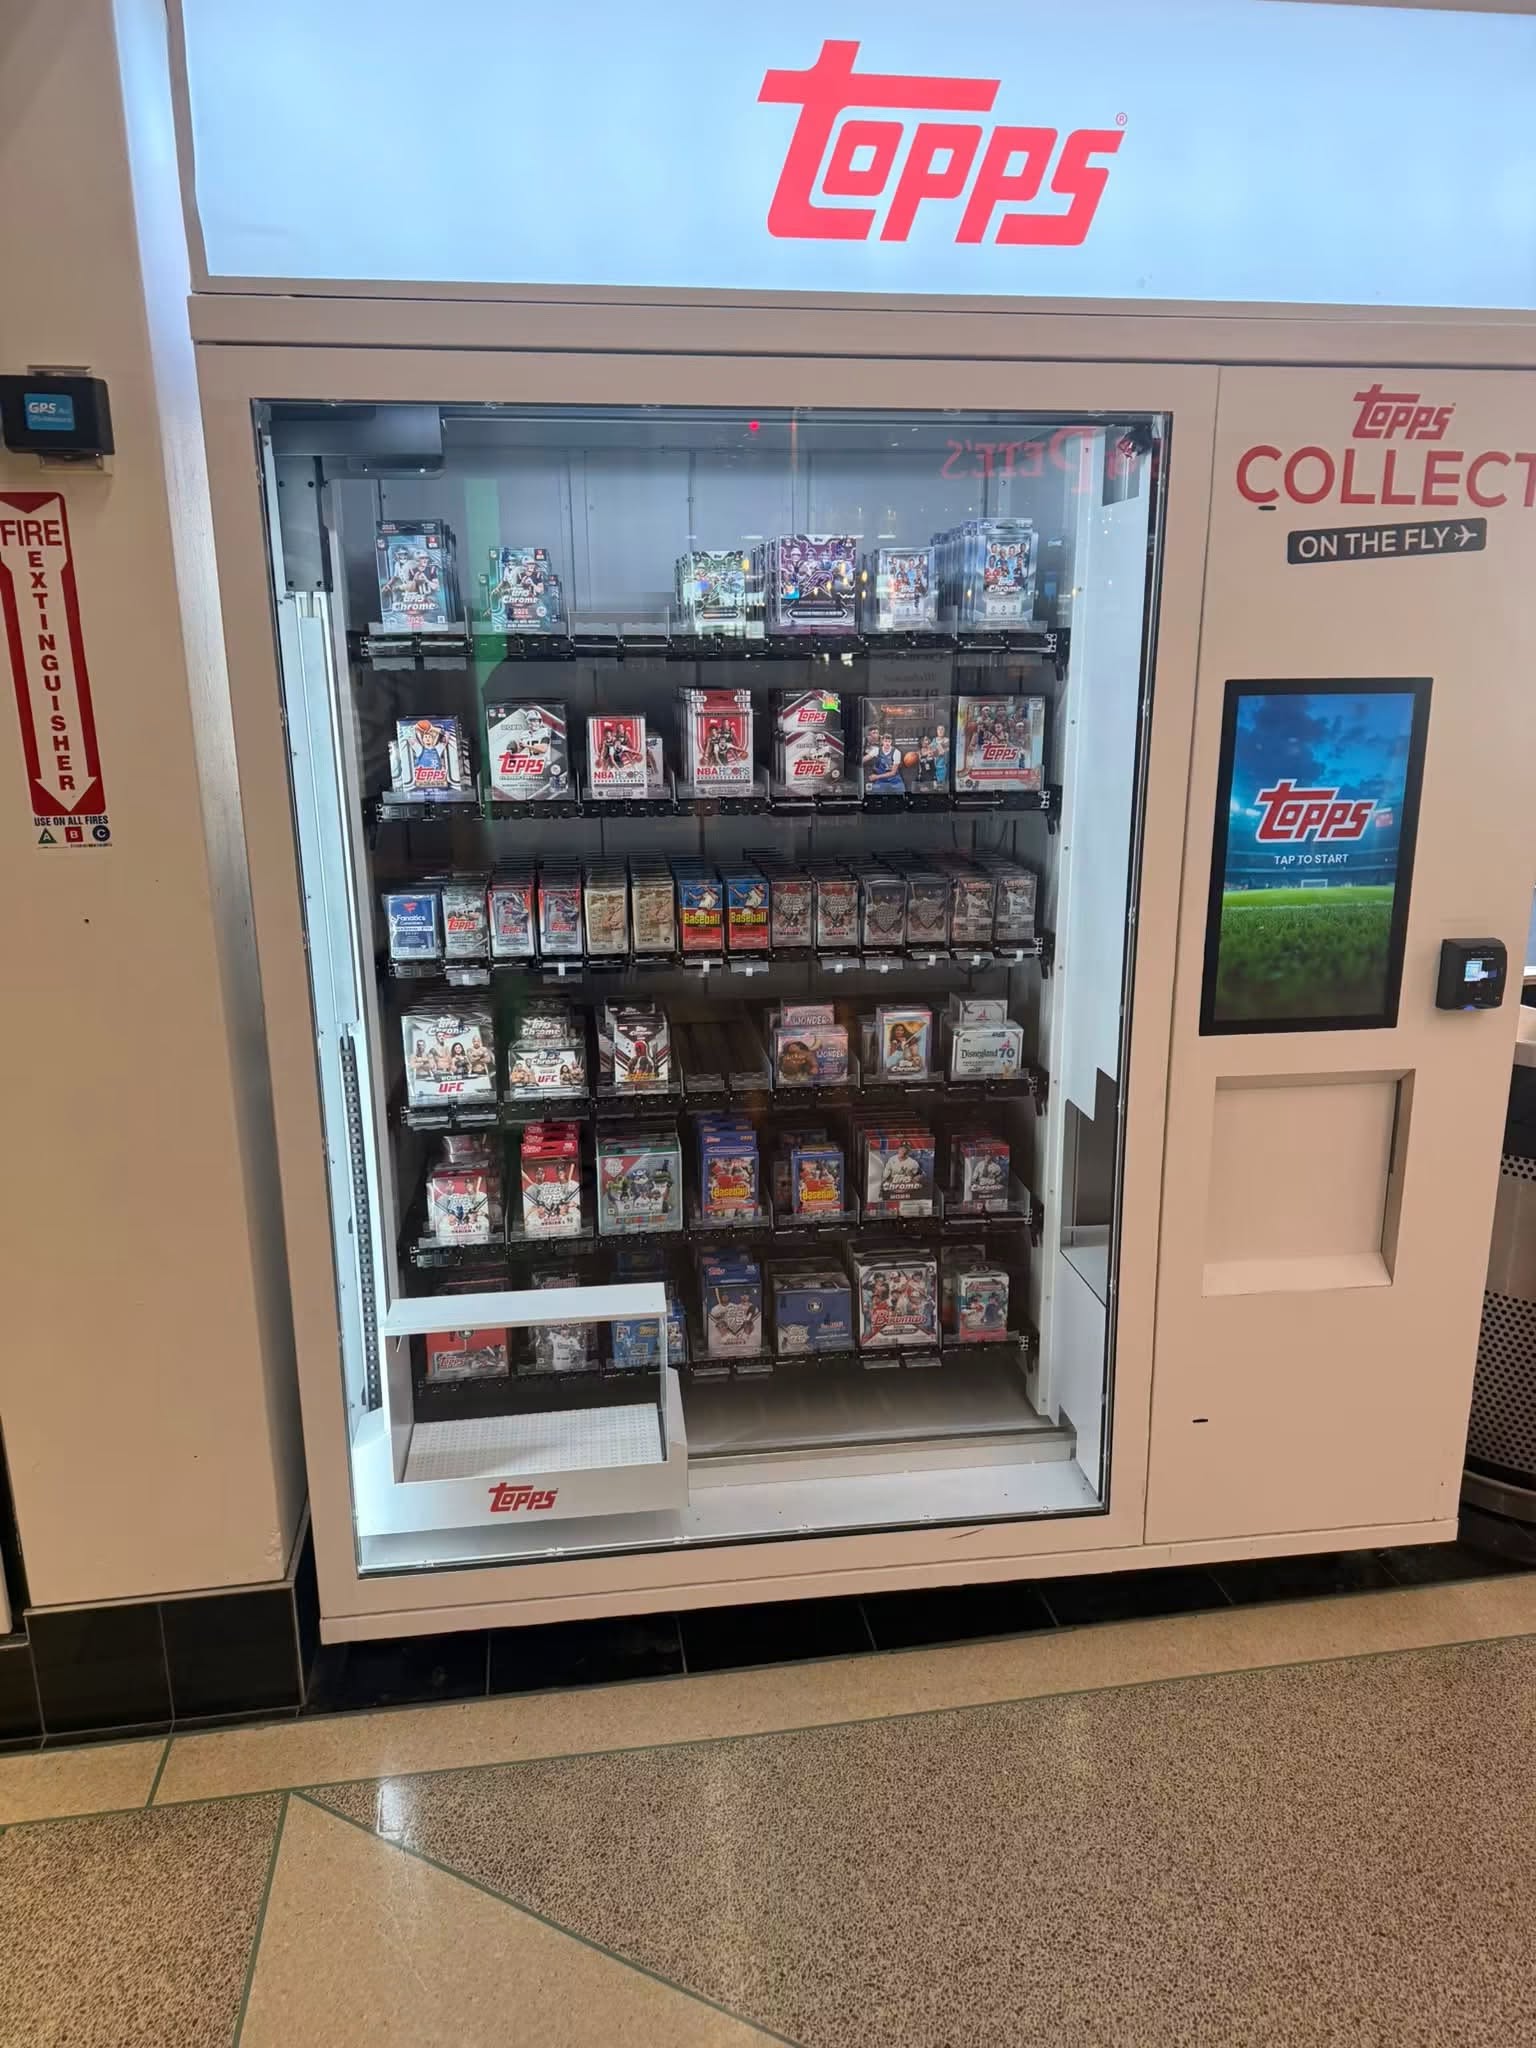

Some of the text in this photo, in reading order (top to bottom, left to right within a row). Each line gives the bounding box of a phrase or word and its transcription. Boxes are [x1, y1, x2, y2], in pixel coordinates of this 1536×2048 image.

[28, 402, 57, 414] GPS
[0, 520, 62, 546] FIRE
[1298, 526, 1450, 559] ON THE FLY
[392, 602, 437, 611] Chrome
[28, 551, 76, 791] EXTINGUISHER
[594, 771, 614, 779] NBA
[697, 767, 718, 776] NBA
[34, 815, 109, 826] USE ON ALL FIRES
[1275, 854, 1349, 865] TAP TO START
[684, 911, 720, 926] Baseball
[730, 911, 767, 924] Baseball
[998, 1048, 1015, 1058] 70
[538, 1075, 557, 1083] UFC
[438, 1082, 465, 1093] UFC
[882, 1183, 921, 1191] Chrome
